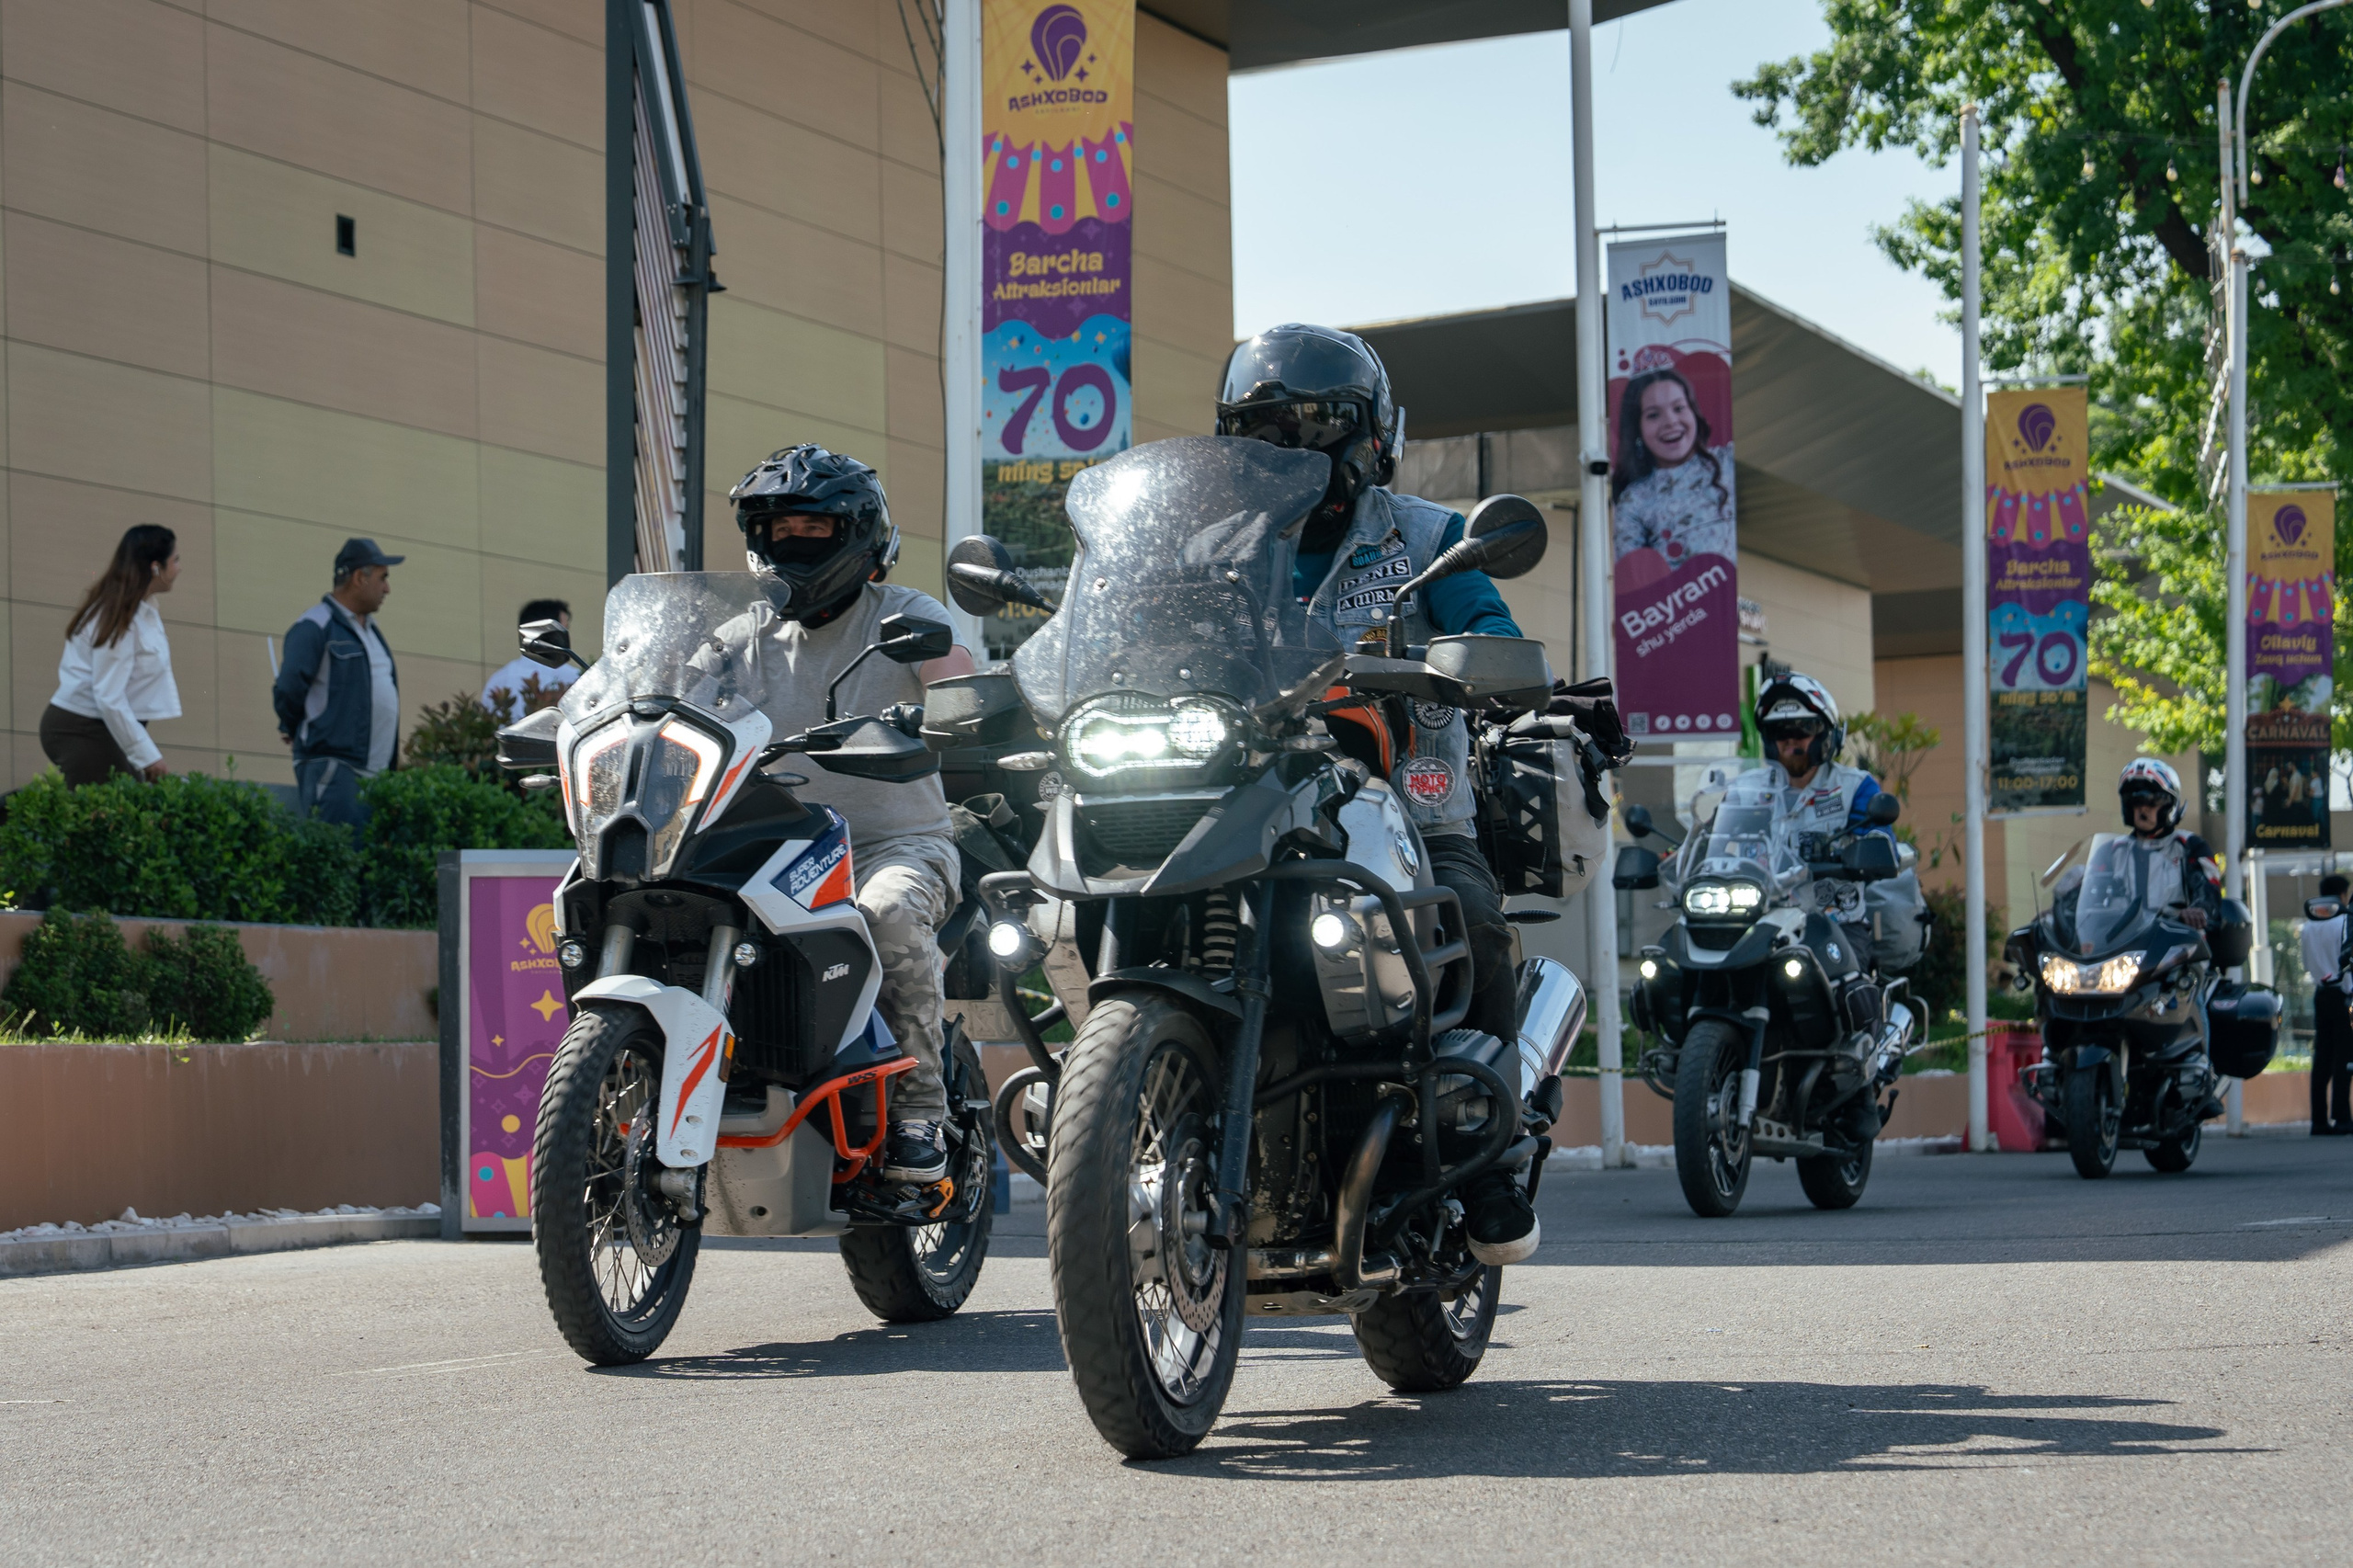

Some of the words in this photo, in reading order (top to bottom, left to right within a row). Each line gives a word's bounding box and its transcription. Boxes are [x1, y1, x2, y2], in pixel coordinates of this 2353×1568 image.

[1008, 87, 1108, 112] ASHXOBOD
[1009, 249, 1104, 277] Barcha
[993, 278, 1121, 301] Attraksionlar
[1621, 273, 1713, 302] ASHXOBOD
[998, 363, 1116, 455] 70
[998, 460, 1054, 484] ming
[1342, 561, 1408, 590] DENIS
[1620, 564, 1728, 639] Bayram
[1635, 634, 1665, 658] shu
[1664, 608, 1708, 643] yerda
[1999, 631, 2078, 687] 70
[2256, 824, 2320, 838] Carnaval
[789, 856, 815, 882] SUPER
[822, 962, 849, 983] KTM
